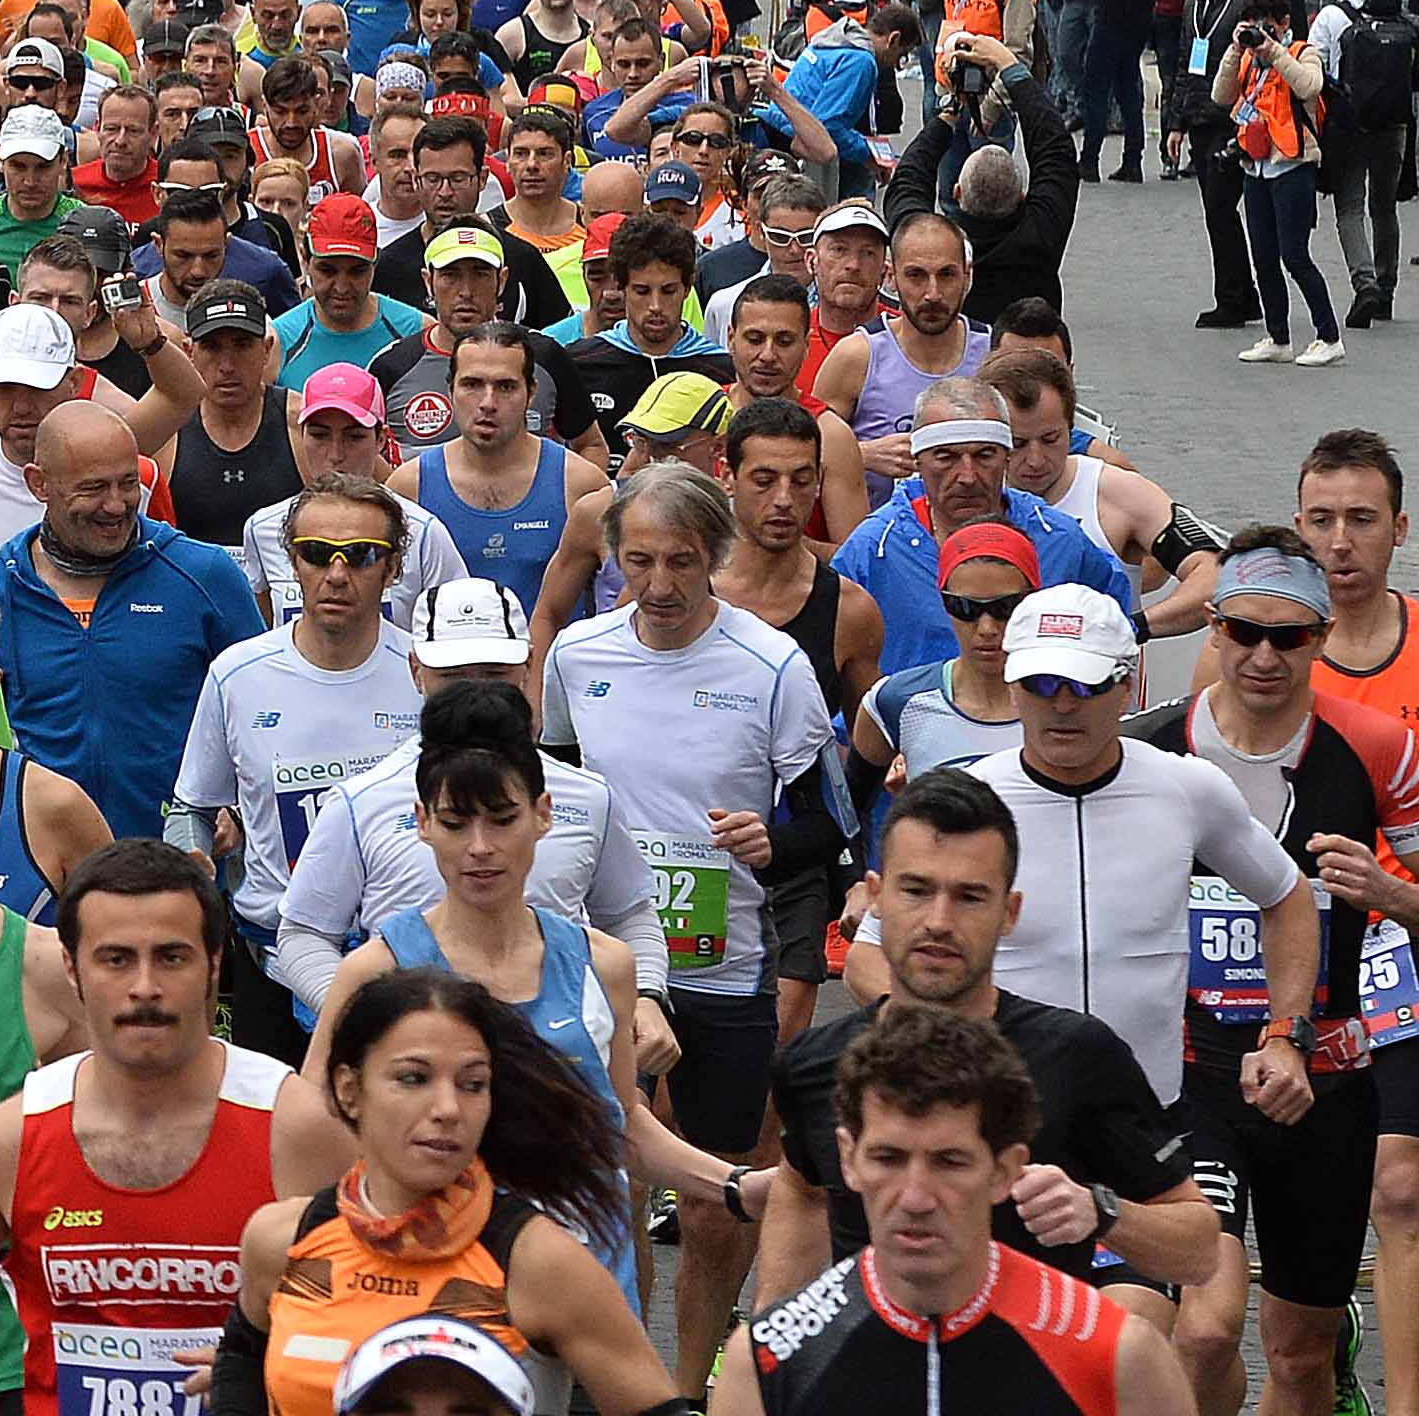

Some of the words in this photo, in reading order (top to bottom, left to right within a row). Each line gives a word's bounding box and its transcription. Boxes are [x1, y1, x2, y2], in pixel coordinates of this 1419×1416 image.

[129, 602, 165, 614] Reebok
[390, 714, 420, 724] MARAT
[276, 760, 344, 785] acea
[636, 837, 667, 858] ea
[651, 869, 696, 912] 92
[1190, 881, 1251, 903] ace
[1201, 917, 1264, 962] 58
[1224, 967, 1267, 982] SIMON
[62, 1209, 104, 1228] asics
[58, 1330, 142, 1362] acea
[149, 1337, 217, 1351] MARATON
